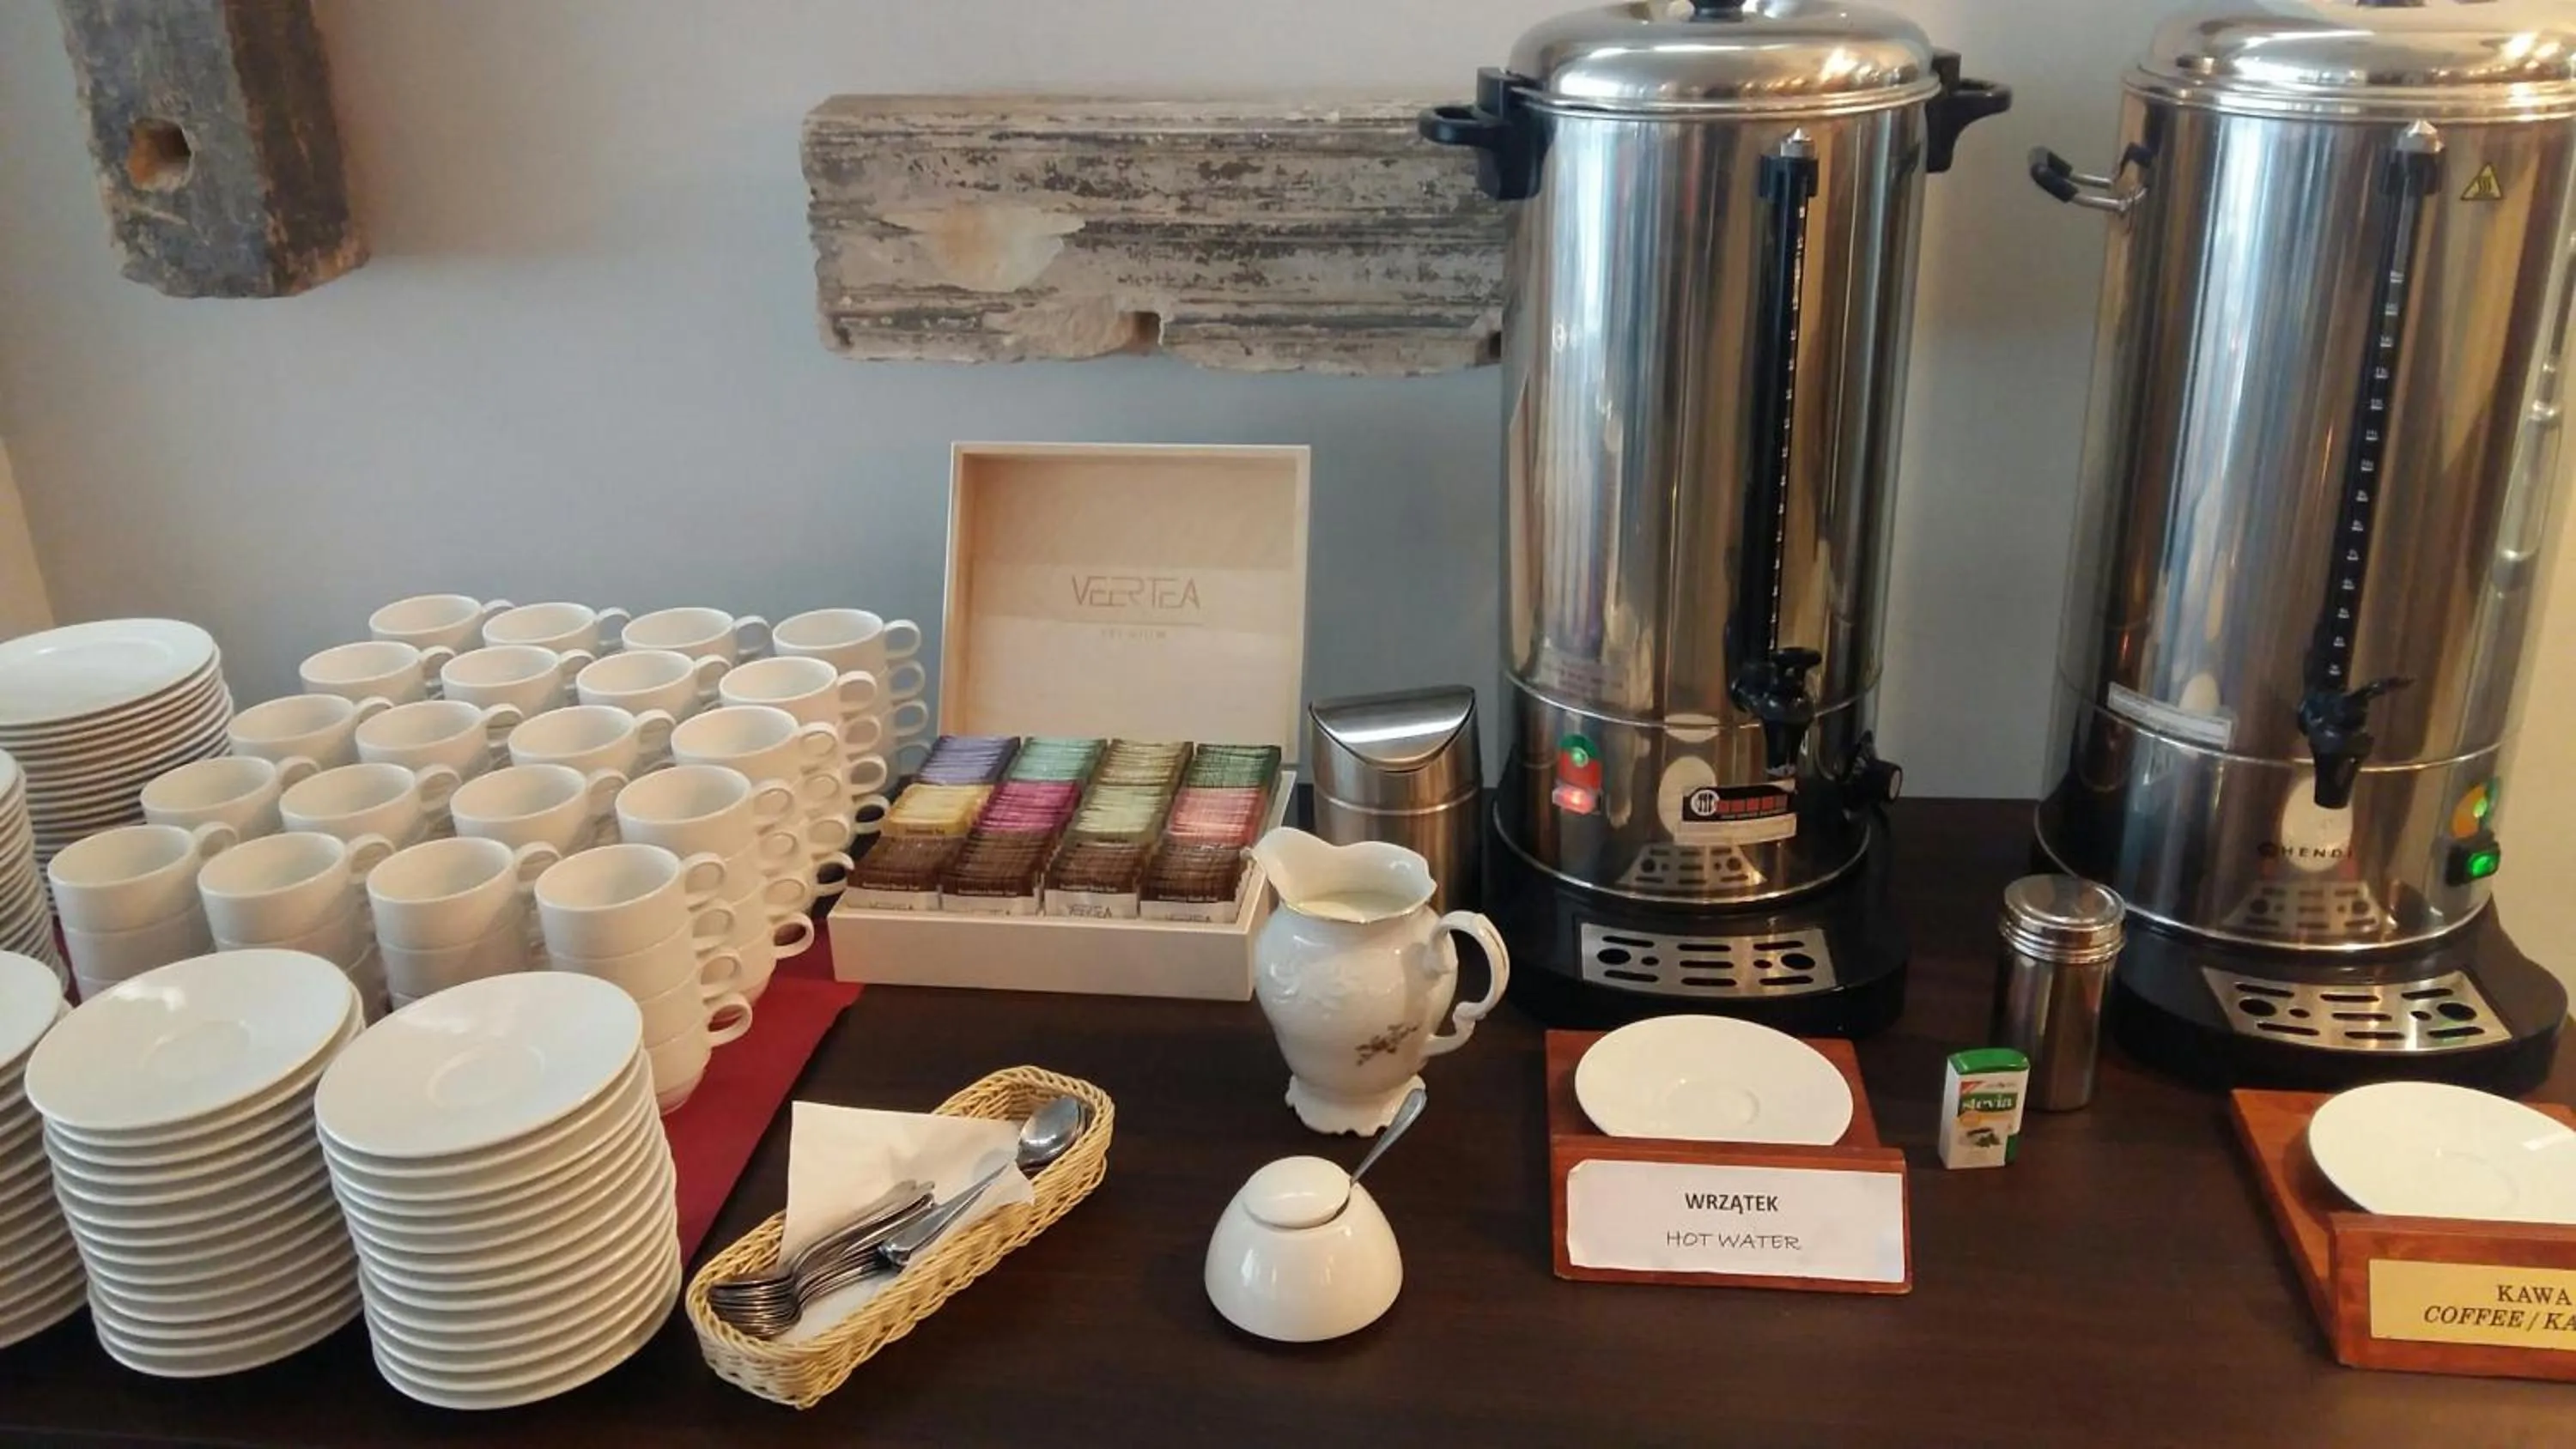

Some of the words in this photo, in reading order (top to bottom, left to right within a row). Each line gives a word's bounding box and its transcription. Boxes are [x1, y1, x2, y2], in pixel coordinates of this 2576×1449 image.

[1072, 574, 1200, 609] VEERTEA
[2281, 846, 2352, 858] HENDI
[1685, 1192, 1778, 1214] WRZĄTEK
[1666, 1231, 1712, 1247] HOT
[1718, 1234, 1801, 1251] WATER
[2497, 1284, 2572, 1306] KAWA
[2424, 1305, 2524, 1328] COFFEE
